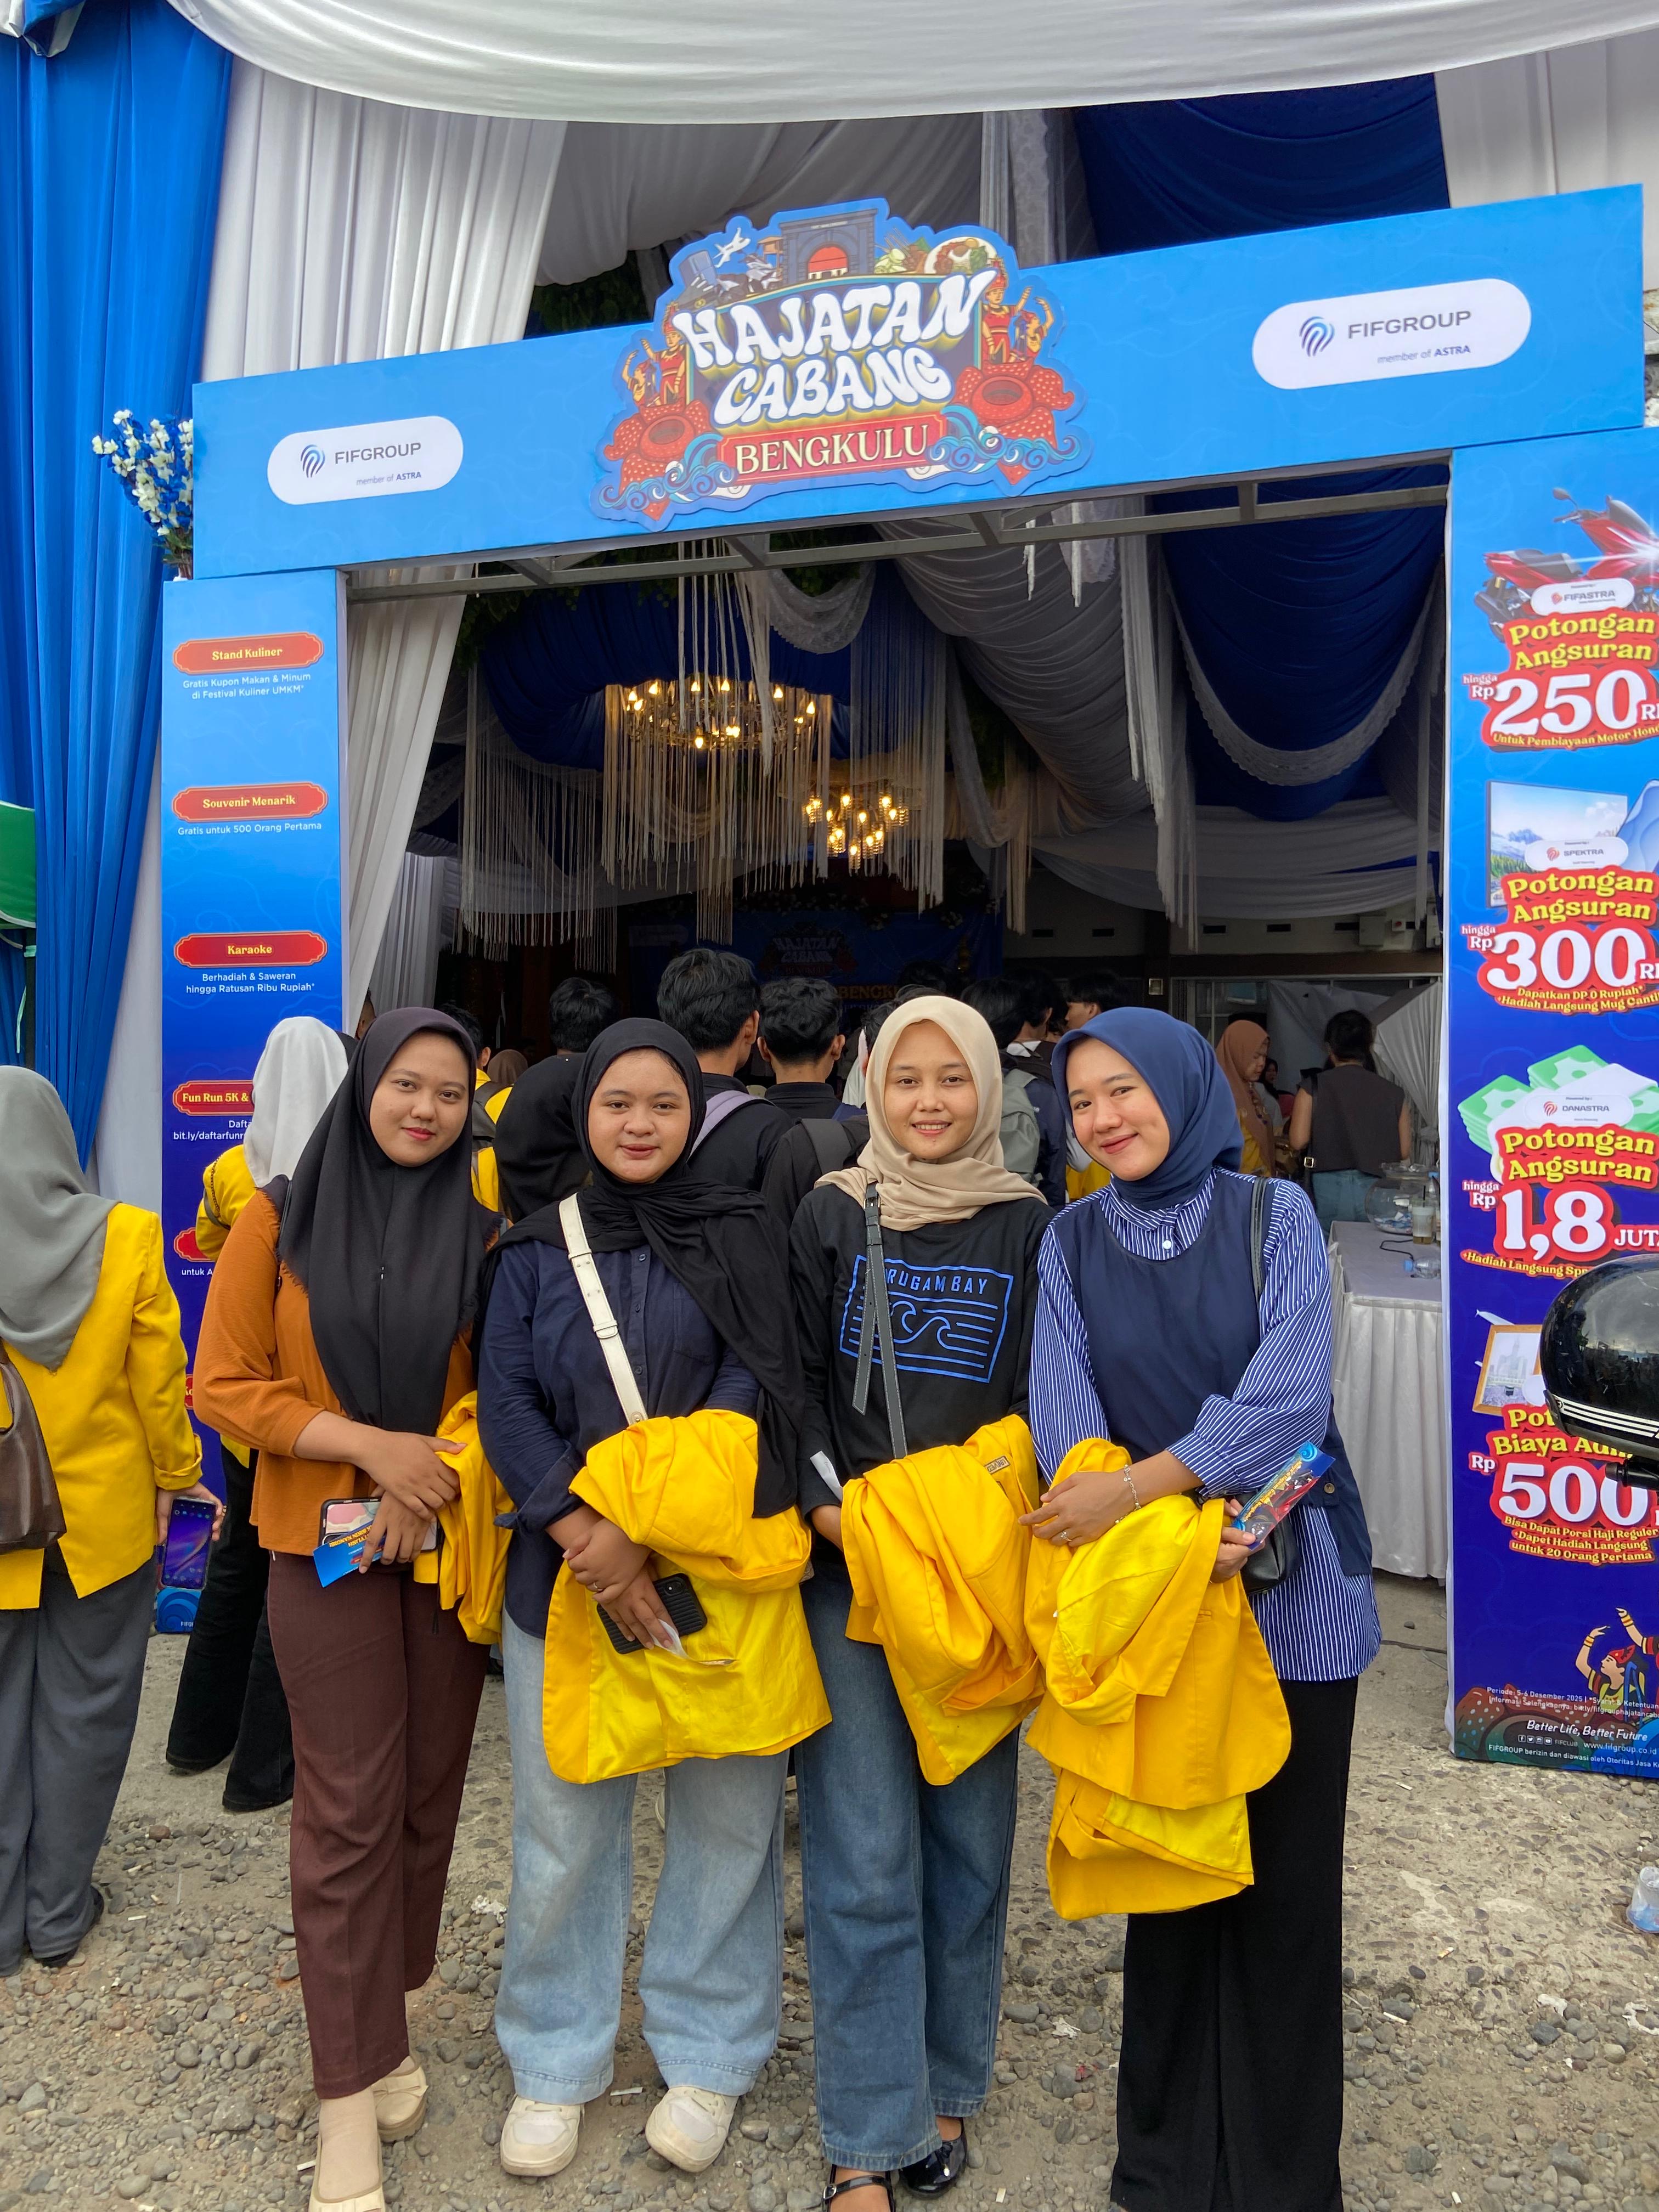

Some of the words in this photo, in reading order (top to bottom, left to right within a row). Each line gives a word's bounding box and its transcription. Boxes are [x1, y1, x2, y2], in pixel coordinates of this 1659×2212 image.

[672, 269, 998, 369] HAJATAN
[1348, 311, 1471, 339] FIFGROUP
[1377, 350, 1418, 364] member
[1420, 349, 1431, 359] of
[1434, 345, 1471, 358] ASTRA
[712, 346, 952, 425] CABANG
[335, 442, 421, 464] FIFGROUP
[735, 424, 929, 476] BENGKULU
[356, 476, 385, 486] member
[387, 474, 394, 482] of
[396, 472, 421, 481] ASTRA
[1564, 589, 1616, 602] FIFASTRA
[1509, 613, 1655, 646] Potongan
[211, 649, 242, 661] Stand
[245, 647, 283, 658] Kuliner
[1515, 643, 1652, 670] Angsuran
[183, 679, 208, 689] Gratis
[211, 678, 239, 688] Kupon
[241, 675, 270, 684] Makan
[273, 674, 279, 682] &
[281, 673, 311, 681] Minum
[1463, 675, 1497, 686] hingga
[192, 690, 200, 699] di
[203, 689, 236, 699] Festival
[239, 686, 270, 696] Kuliner
[1471, 685, 1494, 700] Rp
[1490, 669, 1646, 736] 250
[1493, 733, 1525, 746] Untuk
[1527, 734, 1595, 750] Pembiayaan
[1597, 731, 1631, 744] Motor
[202, 796, 250, 809] Souvenir
[252, 794, 296, 807] Menarik
[178, 826, 203, 836] Gratis
[206, 825, 231, 834] untuk
[233, 825, 251, 833] 500
[254, 824, 281, 834] Orang
[284, 822, 321, 831] Pertama
[1564, 848, 1604, 857] SPEKTRA
[1507, 871, 1654, 899] Potongan
[1513, 899, 1651, 924] Angsuran
[1462, 925, 1496, 936] hingga
[228, 944, 273, 956] Karaoke
[1470, 936, 1493, 950] Rp
[1486, 928, 1646, 989] 300
[202, 973, 247, 981] Berhadiah
[258, 972, 296, 980] Saweran
[186, 984, 217, 995] hingga
[219, 984, 255, 992] Ratusan
[257, 983, 278, 992] Ribu
[1517, 987, 1571, 1002] Dapatkan
[1572, 991, 1588, 1000] DP
[1590, 990, 1598, 999] 0
[1543, 1000, 1598, 1013] Langsung
[1601, 1000, 1626, 1011] Mug
[182, 1093, 201, 1102] Fun
[203, 1093, 223, 1102] Run
[225, 1092, 239, 1102] 5K
[241, 1093, 249, 1102] &
[1502, 1130, 1655, 1156] Potongan
[1509, 1156, 1651, 1183] Angsuran
[1463, 1181, 1499, 1193] hingga
[1472, 1193, 1496, 1209] Rp
[1502, 1189, 1606, 1260] 1,8
[1614, 1228, 1659, 1246] JUT
[182, 1267, 205, 1276] untuk
[1509, 1260, 1564, 1278] Langsung
[885, 1268, 946, 1292] RUGAM
[951, 1275, 988, 1294] BAY
[1493, 1434, 1567, 1457] Biaya
[1471, 1455, 1496, 1474] Rp
[1499, 1463, 1648, 1526] 500
[1504, 1515, 1528, 1528] Bisa
[1530, 1522, 1560, 1536] Dapat
[1562, 1528, 1592, 1538] Porsi
[1593, 1528, 1614, 1541] Haji
[1616, 1528, 1658, 1541] Reguler
[1512, 1541, 1544, 1555] untuk
[1546, 1547, 1561, 1557] 20
[1563, 1550, 1599, 1564] Orang
[1601, 1550, 1652, 1561] Pertama
[1553, 1537, 1592, 1549] Hadiah
[1594, 1540, 1648, 1551] Langsung
[1487, 1687, 1515, 1696] Periode:
[1530, 1691, 1564, 1700] Desember
[1624, 1700, 1659, 1709] Ketentuan
[1489, 1696, 1521, 1706] Informasi
[1527, 1720, 1558, 1733] Better
[1560, 1723, 1580, 1737] Life,
[1582, 1726, 1615, 1739] Better
[1616, 1729, 1648, 1741] Future
[1488, 1744, 1523, 1753] FIFGROUP
[1525, 1748, 1548, 1756] berizin
[1564, 1753, 1589, 1761] diawasi
[1606, 1757, 1634, 1765] Otoritas
